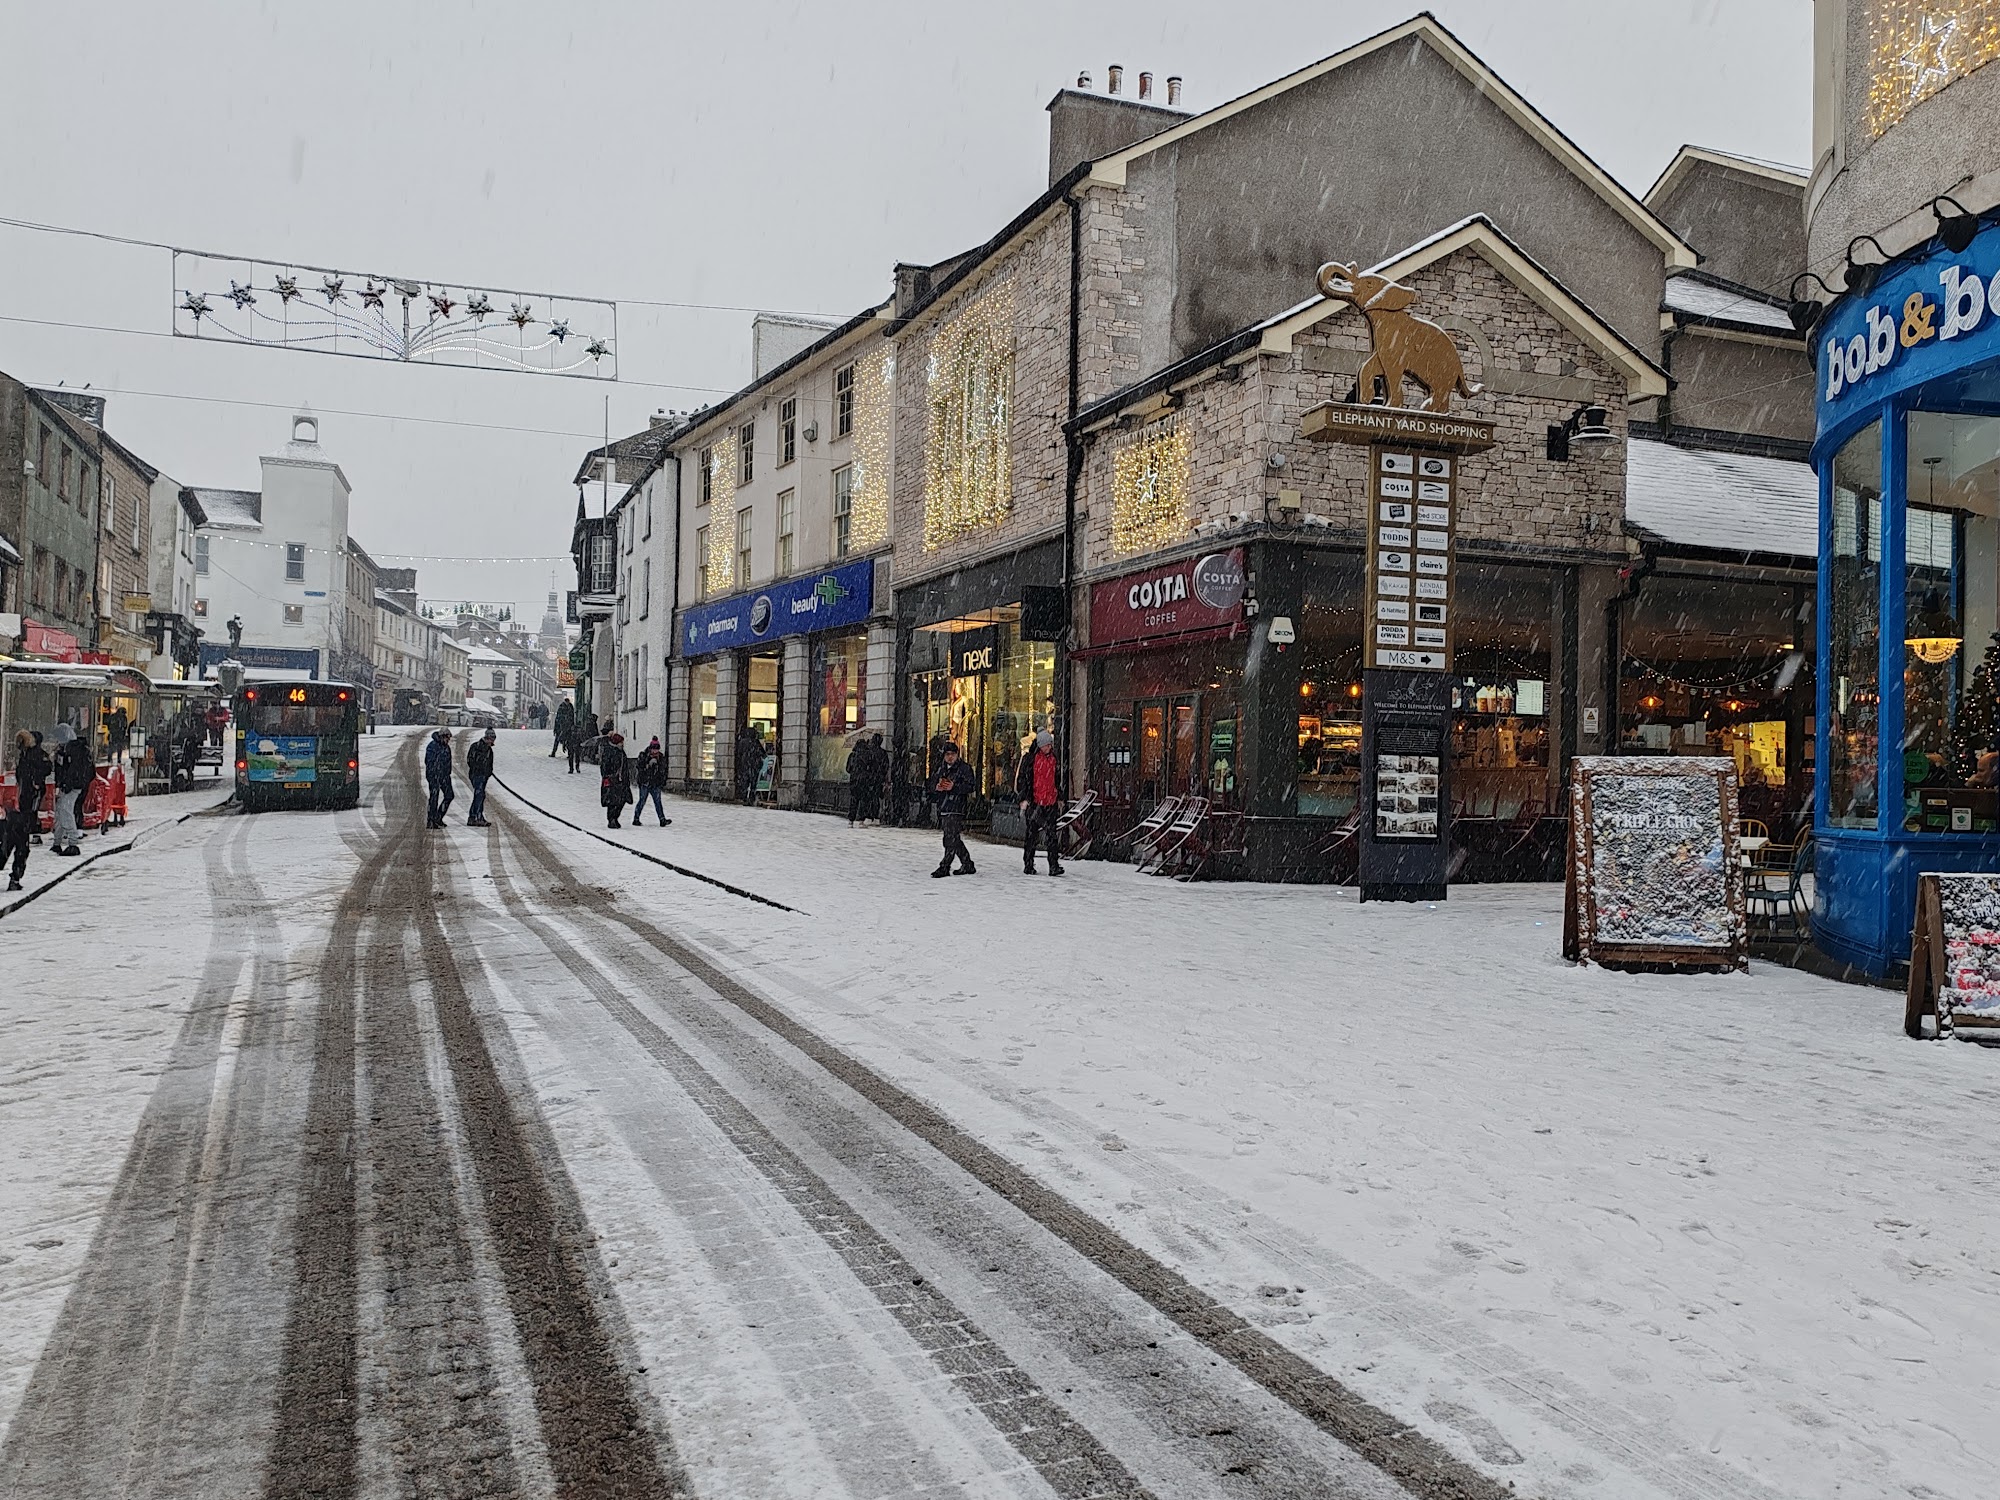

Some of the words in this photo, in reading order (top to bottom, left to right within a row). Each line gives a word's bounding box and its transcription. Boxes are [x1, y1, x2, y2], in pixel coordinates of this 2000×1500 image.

[1332, 411, 1392, 428] ELEPHANT
[1394, 418, 1427, 433] YARD
[1429, 422, 1488, 439] SHOPPING
[1384, 483, 1410, 492] COSTA
[1431, 513, 1447, 521] STORE
[1381, 533, 1409, 542] TODDS
[1420, 560, 1443, 570] claire's
[1202, 571, 1241, 585] COSTA
[1128, 573, 1188, 609] COSTA
[1210, 584, 1233, 592] COFFEE
[1419, 582, 1444, 590] KENDAL
[791, 594, 819, 614] beauty
[1144, 611, 1177, 627] COFFEE
[1421, 612, 1440, 620] next
[707, 615, 739, 638] pharmacy
[1034, 629, 1061, 639] next
[962, 645, 993, 672] next
[1388, 652, 1416, 665] M&S
[289, 688, 306, 702] 46
